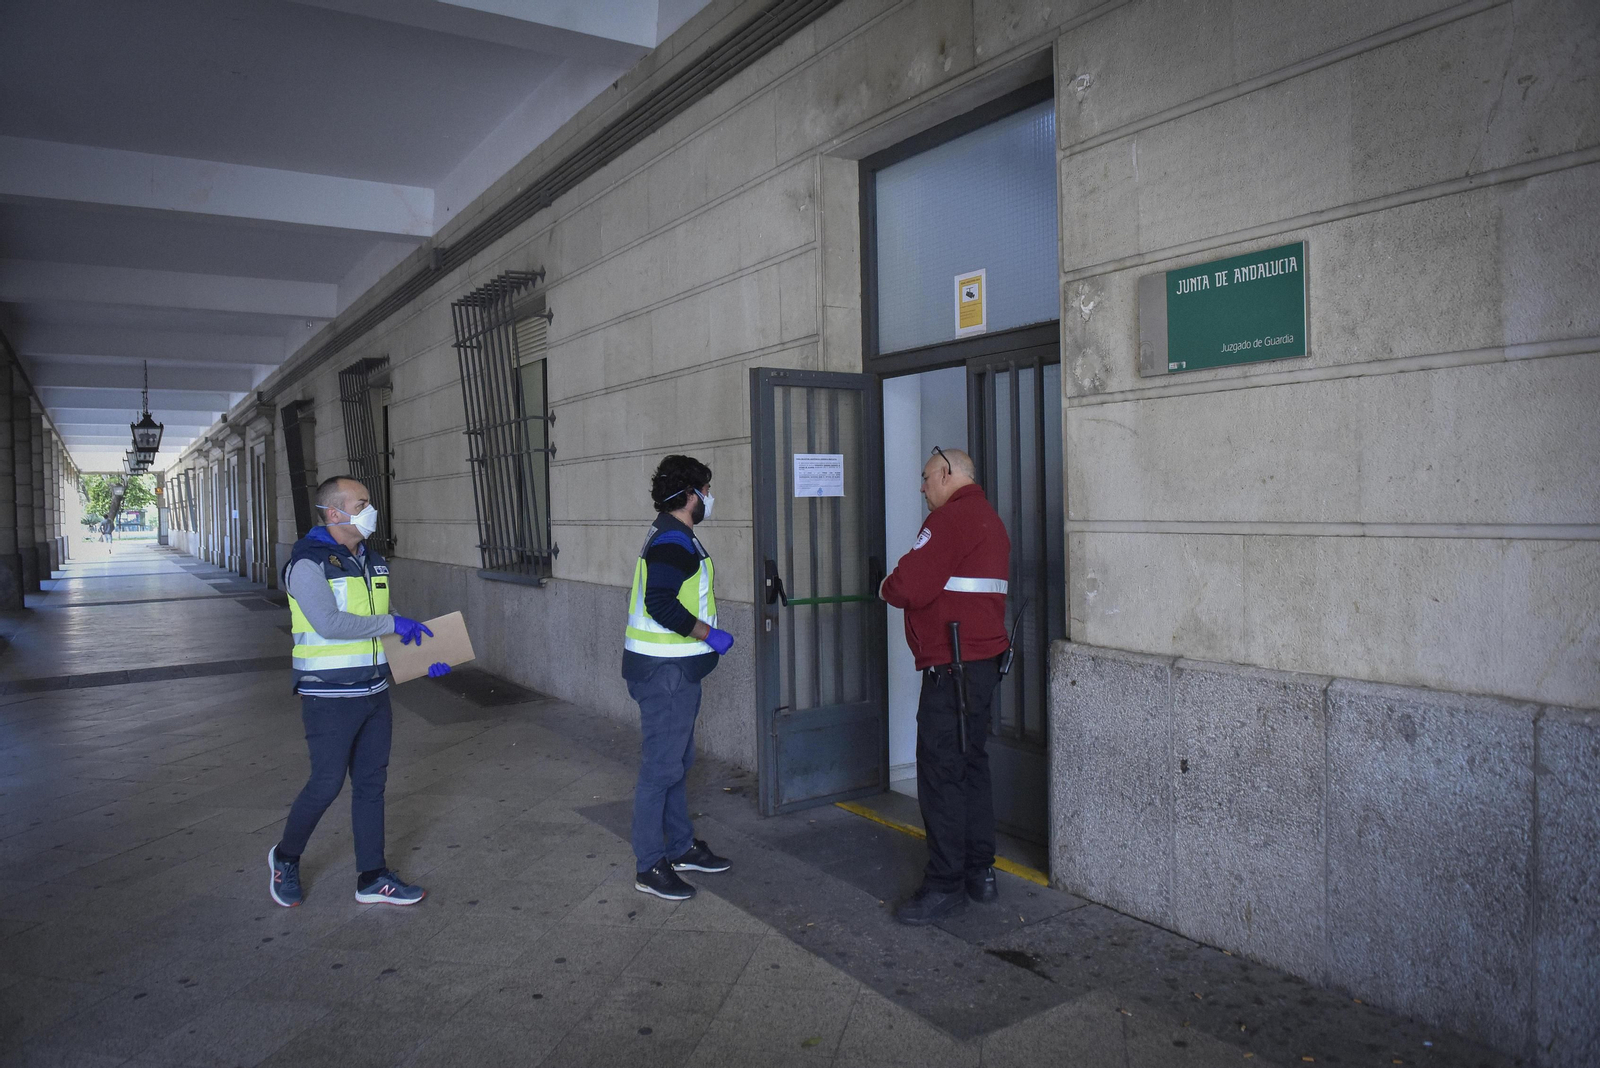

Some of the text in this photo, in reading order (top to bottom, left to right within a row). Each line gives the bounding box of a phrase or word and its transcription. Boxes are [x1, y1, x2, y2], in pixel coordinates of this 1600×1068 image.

[1176, 257, 1298, 295] JUNTA DE ANDALUCIA
[1221, 334, 1294, 353] Juzgado de Guardia
[378, 884, 396, 896] N
